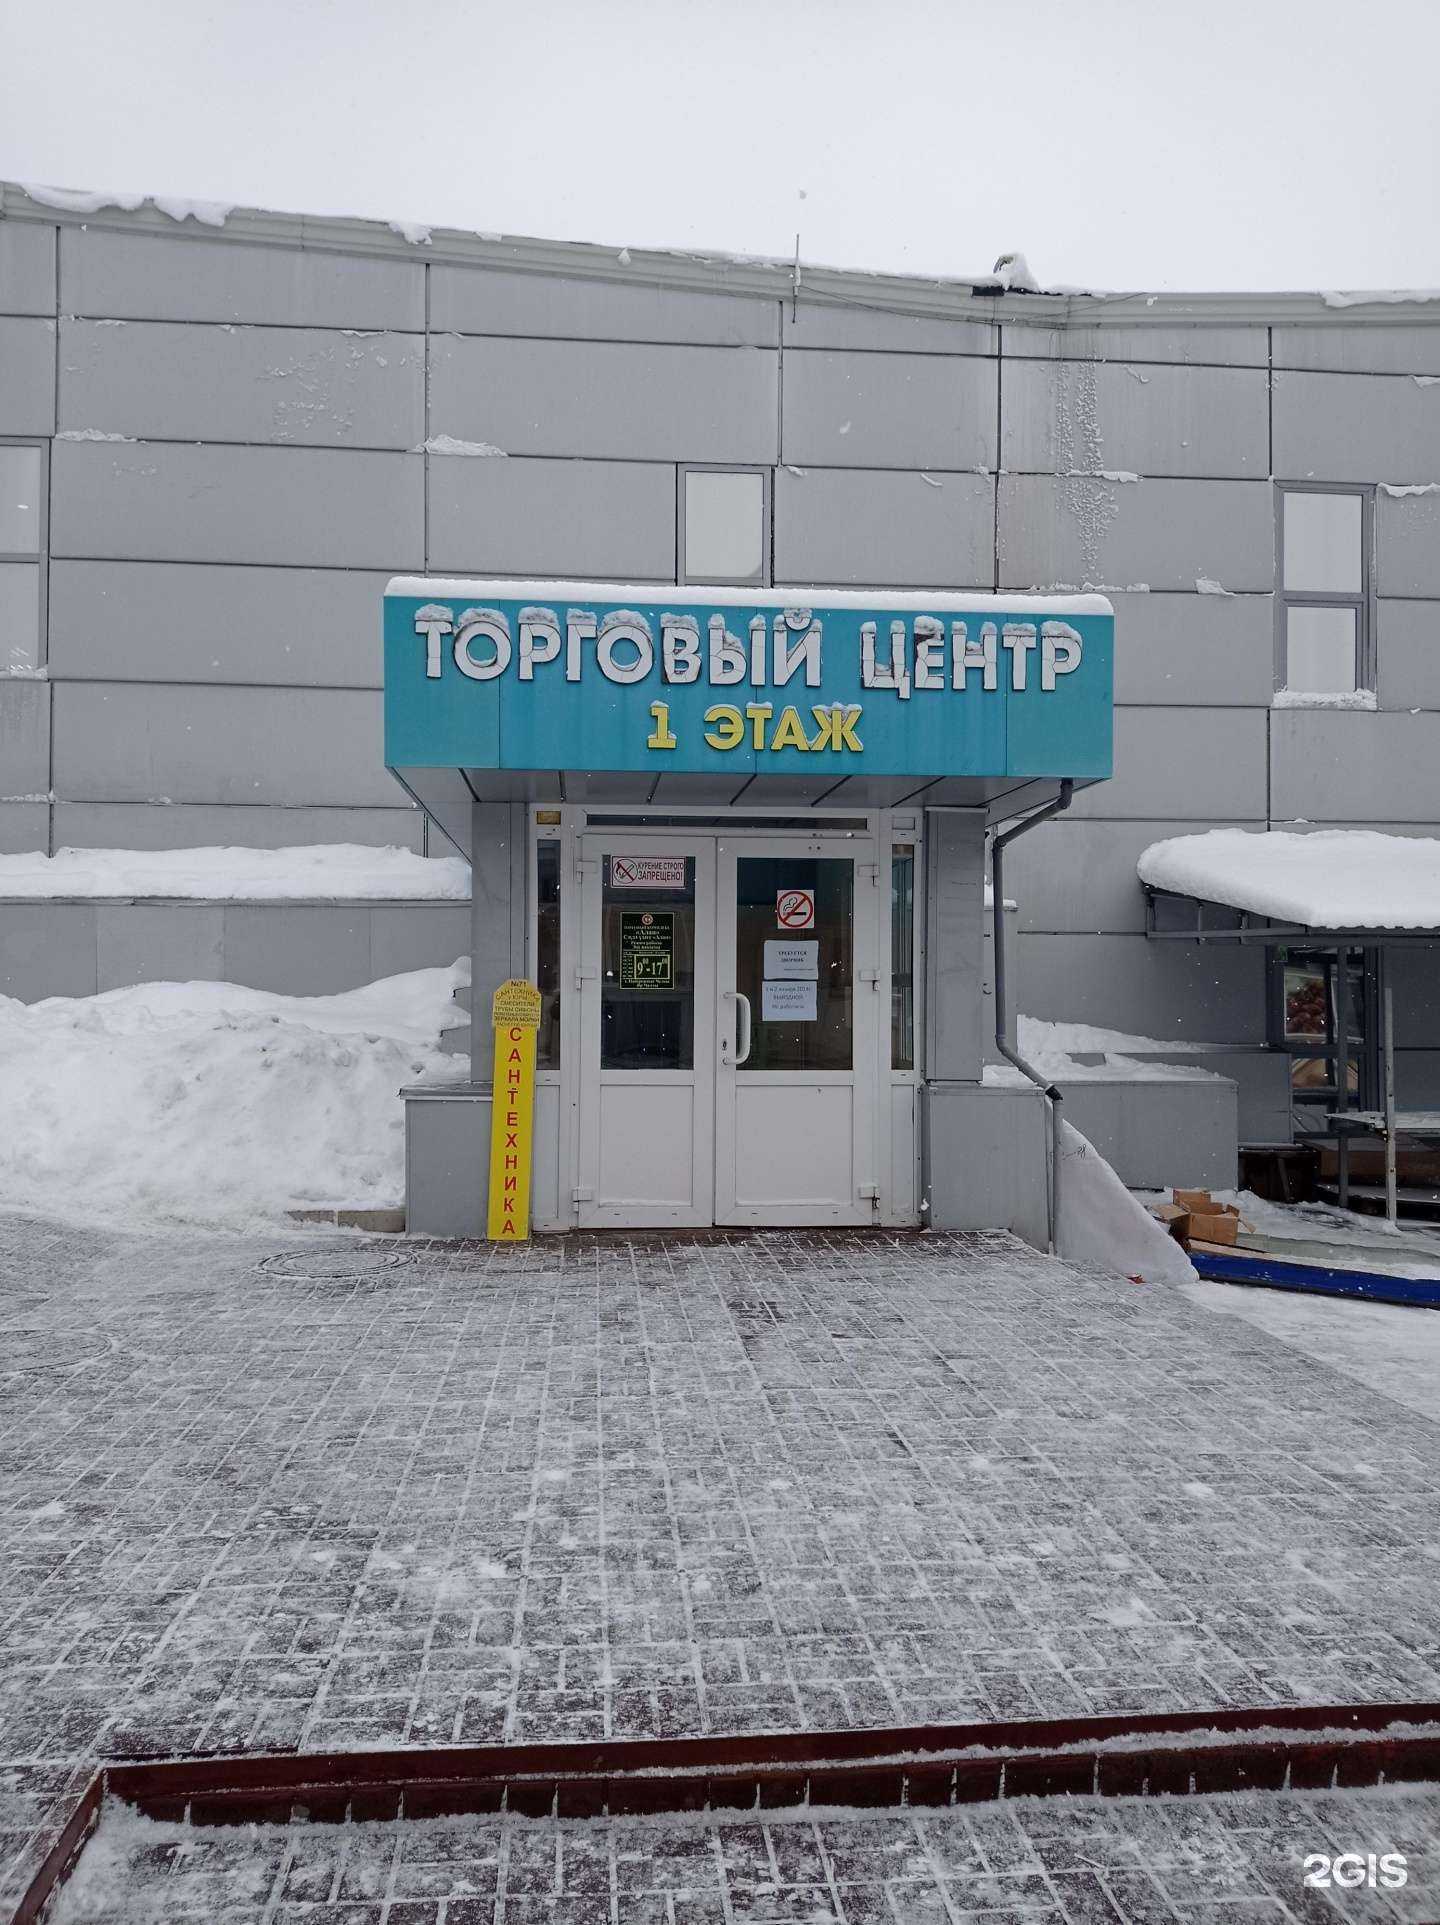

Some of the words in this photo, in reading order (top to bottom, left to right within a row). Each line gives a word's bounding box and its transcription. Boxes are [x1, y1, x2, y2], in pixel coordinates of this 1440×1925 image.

[414, 606, 823, 688] ТОРГОВЫЙ
[860, 619, 1083, 699] ЦЕНТР
[648, 703, 677, 750] 1
[704, 704, 864, 752] ЭТАЖ
[638, 862, 663, 870] КУРЕНИЕ
[664, 862, 684, 870] СТРОГО
[638, 871, 683, 882] ЗАПРЕЩЕНО!
[502, 1027, 522, 1235] САНТЕХНИКА
